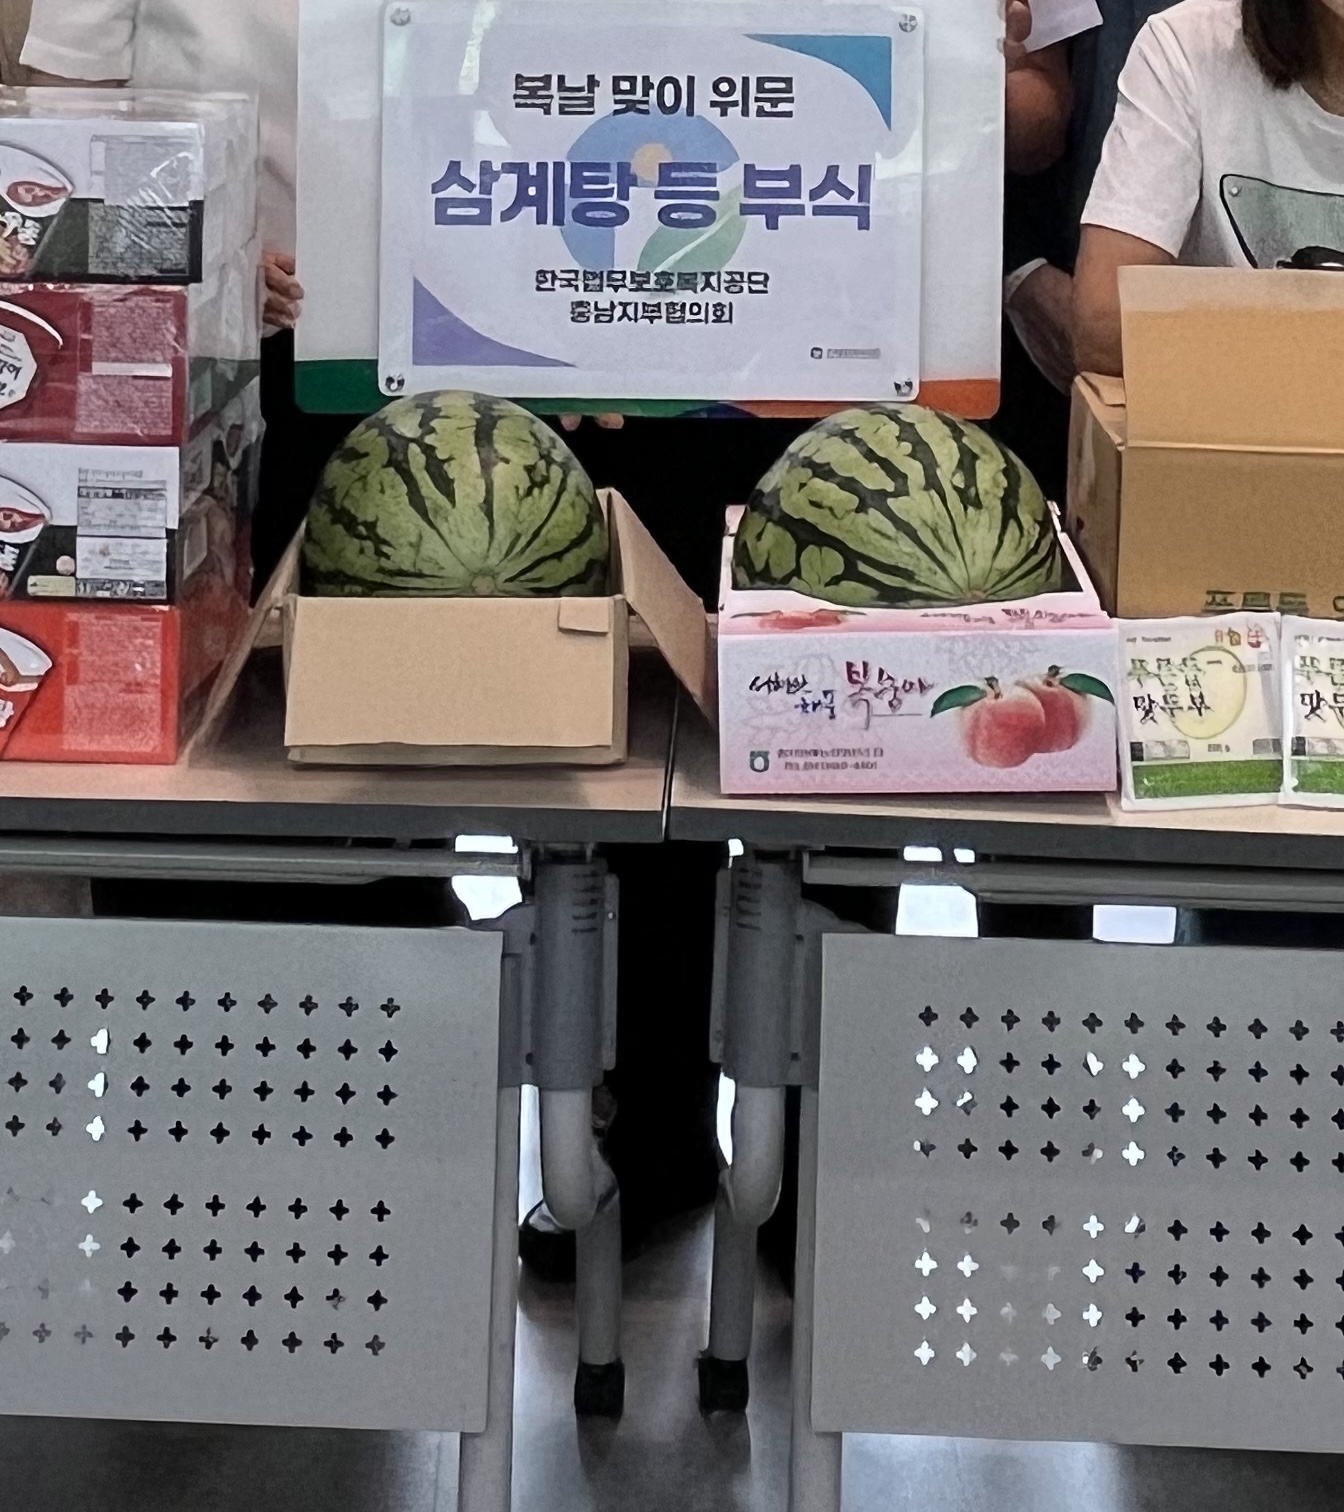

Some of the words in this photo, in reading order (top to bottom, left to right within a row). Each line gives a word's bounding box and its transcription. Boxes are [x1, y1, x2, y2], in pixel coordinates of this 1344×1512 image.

[512, 73, 599, 117] 복날
[611, 74, 695, 118] 맞이
[709, 74, 795, 119] 위문
[430, 159, 638, 229] 삼계탕
[652, 162, 720, 229] 등
[738, 162, 874, 232] 부식
